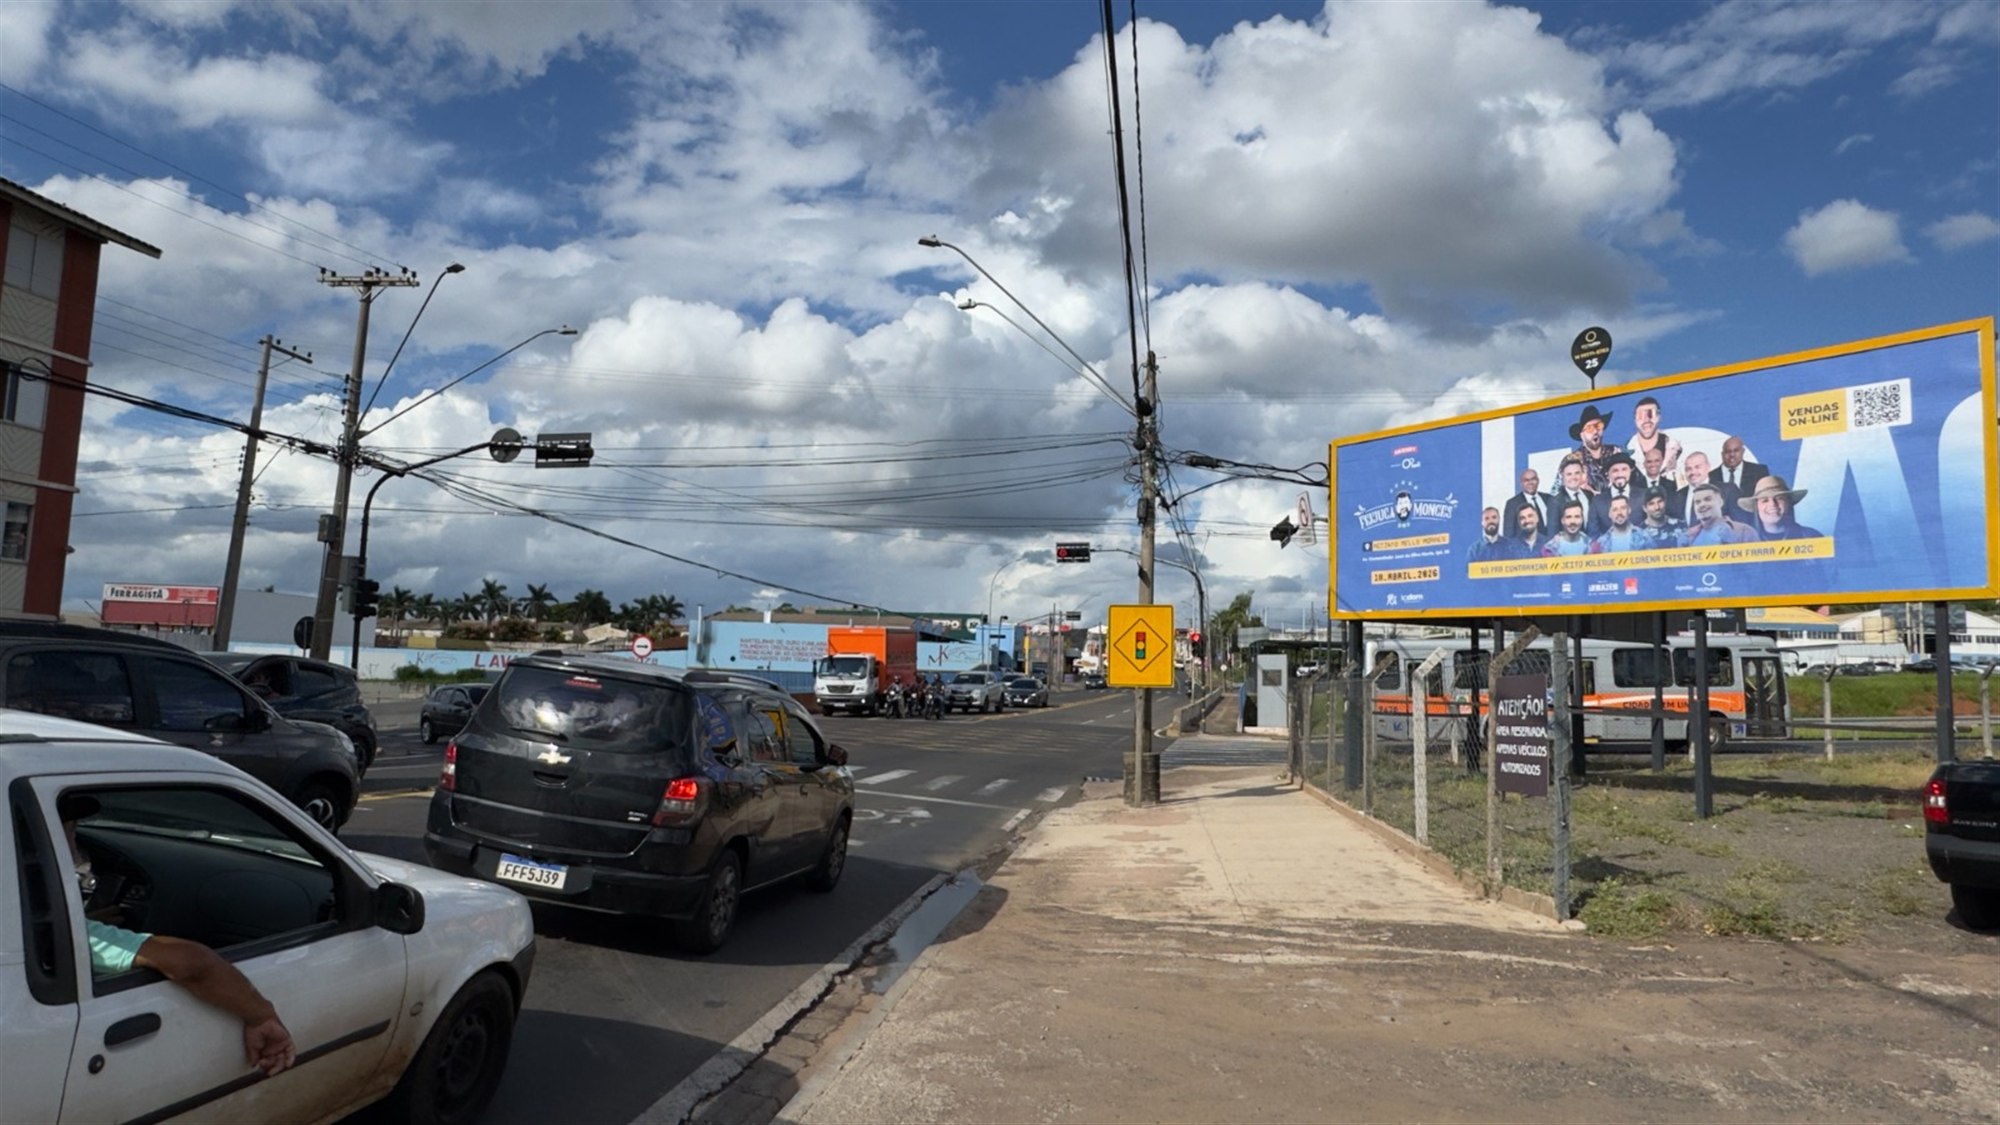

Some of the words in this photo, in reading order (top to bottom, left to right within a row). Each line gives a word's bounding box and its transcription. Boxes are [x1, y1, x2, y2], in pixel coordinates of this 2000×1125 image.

[1584, 357, 1599, 369] 25
[1787, 402, 1840, 417] VENDAS
[1788, 412, 1840, 427] ON-LINE
[1561, 560, 1583, 570] JEITO
[1630, 556, 1660, 565] LORENA
[1663, 553, 1703, 562] CRISTINE
[1719, 549, 1743, 559] OPEN
[1745, 547, 1775, 556] FARRA
[110, 587, 163, 599] FERRAGISTA
[1498, 694, 1544, 720] ATENÇÃO!
[1622, 701, 1650, 709] CIDAD
[1496, 743, 1517, 755] APENAS
[1518, 741, 1548, 757] VEÍCULOS
[1501, 761, 1541, 776] AUTORIZADOS
[503, 863, 560, 885] FFF5J39
